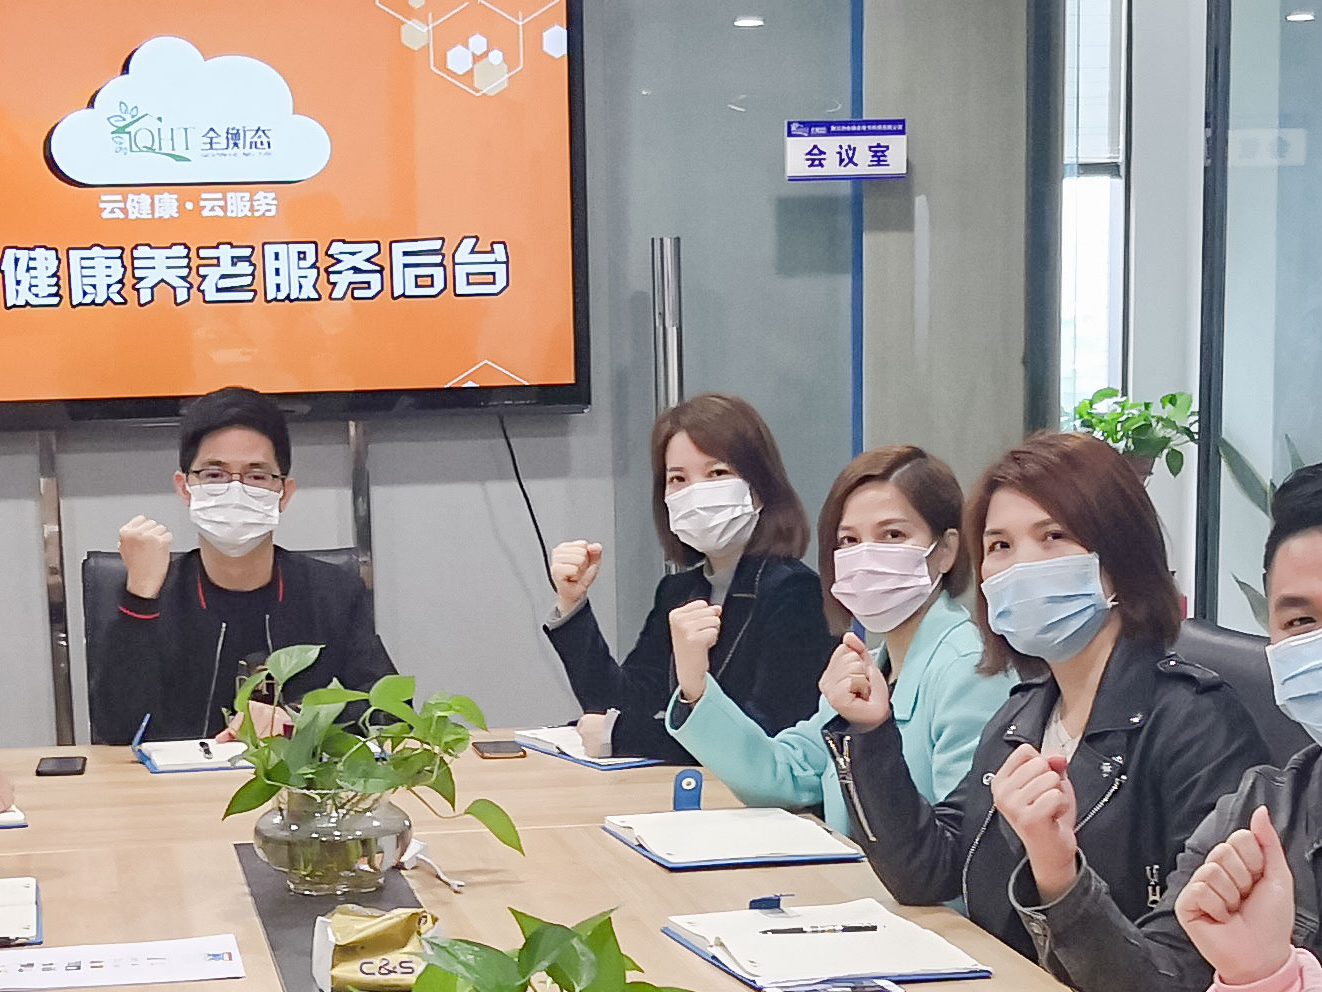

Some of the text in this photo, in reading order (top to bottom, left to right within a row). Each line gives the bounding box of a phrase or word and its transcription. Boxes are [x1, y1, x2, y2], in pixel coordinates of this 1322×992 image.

[200, 125, 272, 151] 全衡态
[804, 142, 890, 168] 会议室
[359, 957, 415, 976] C&S
